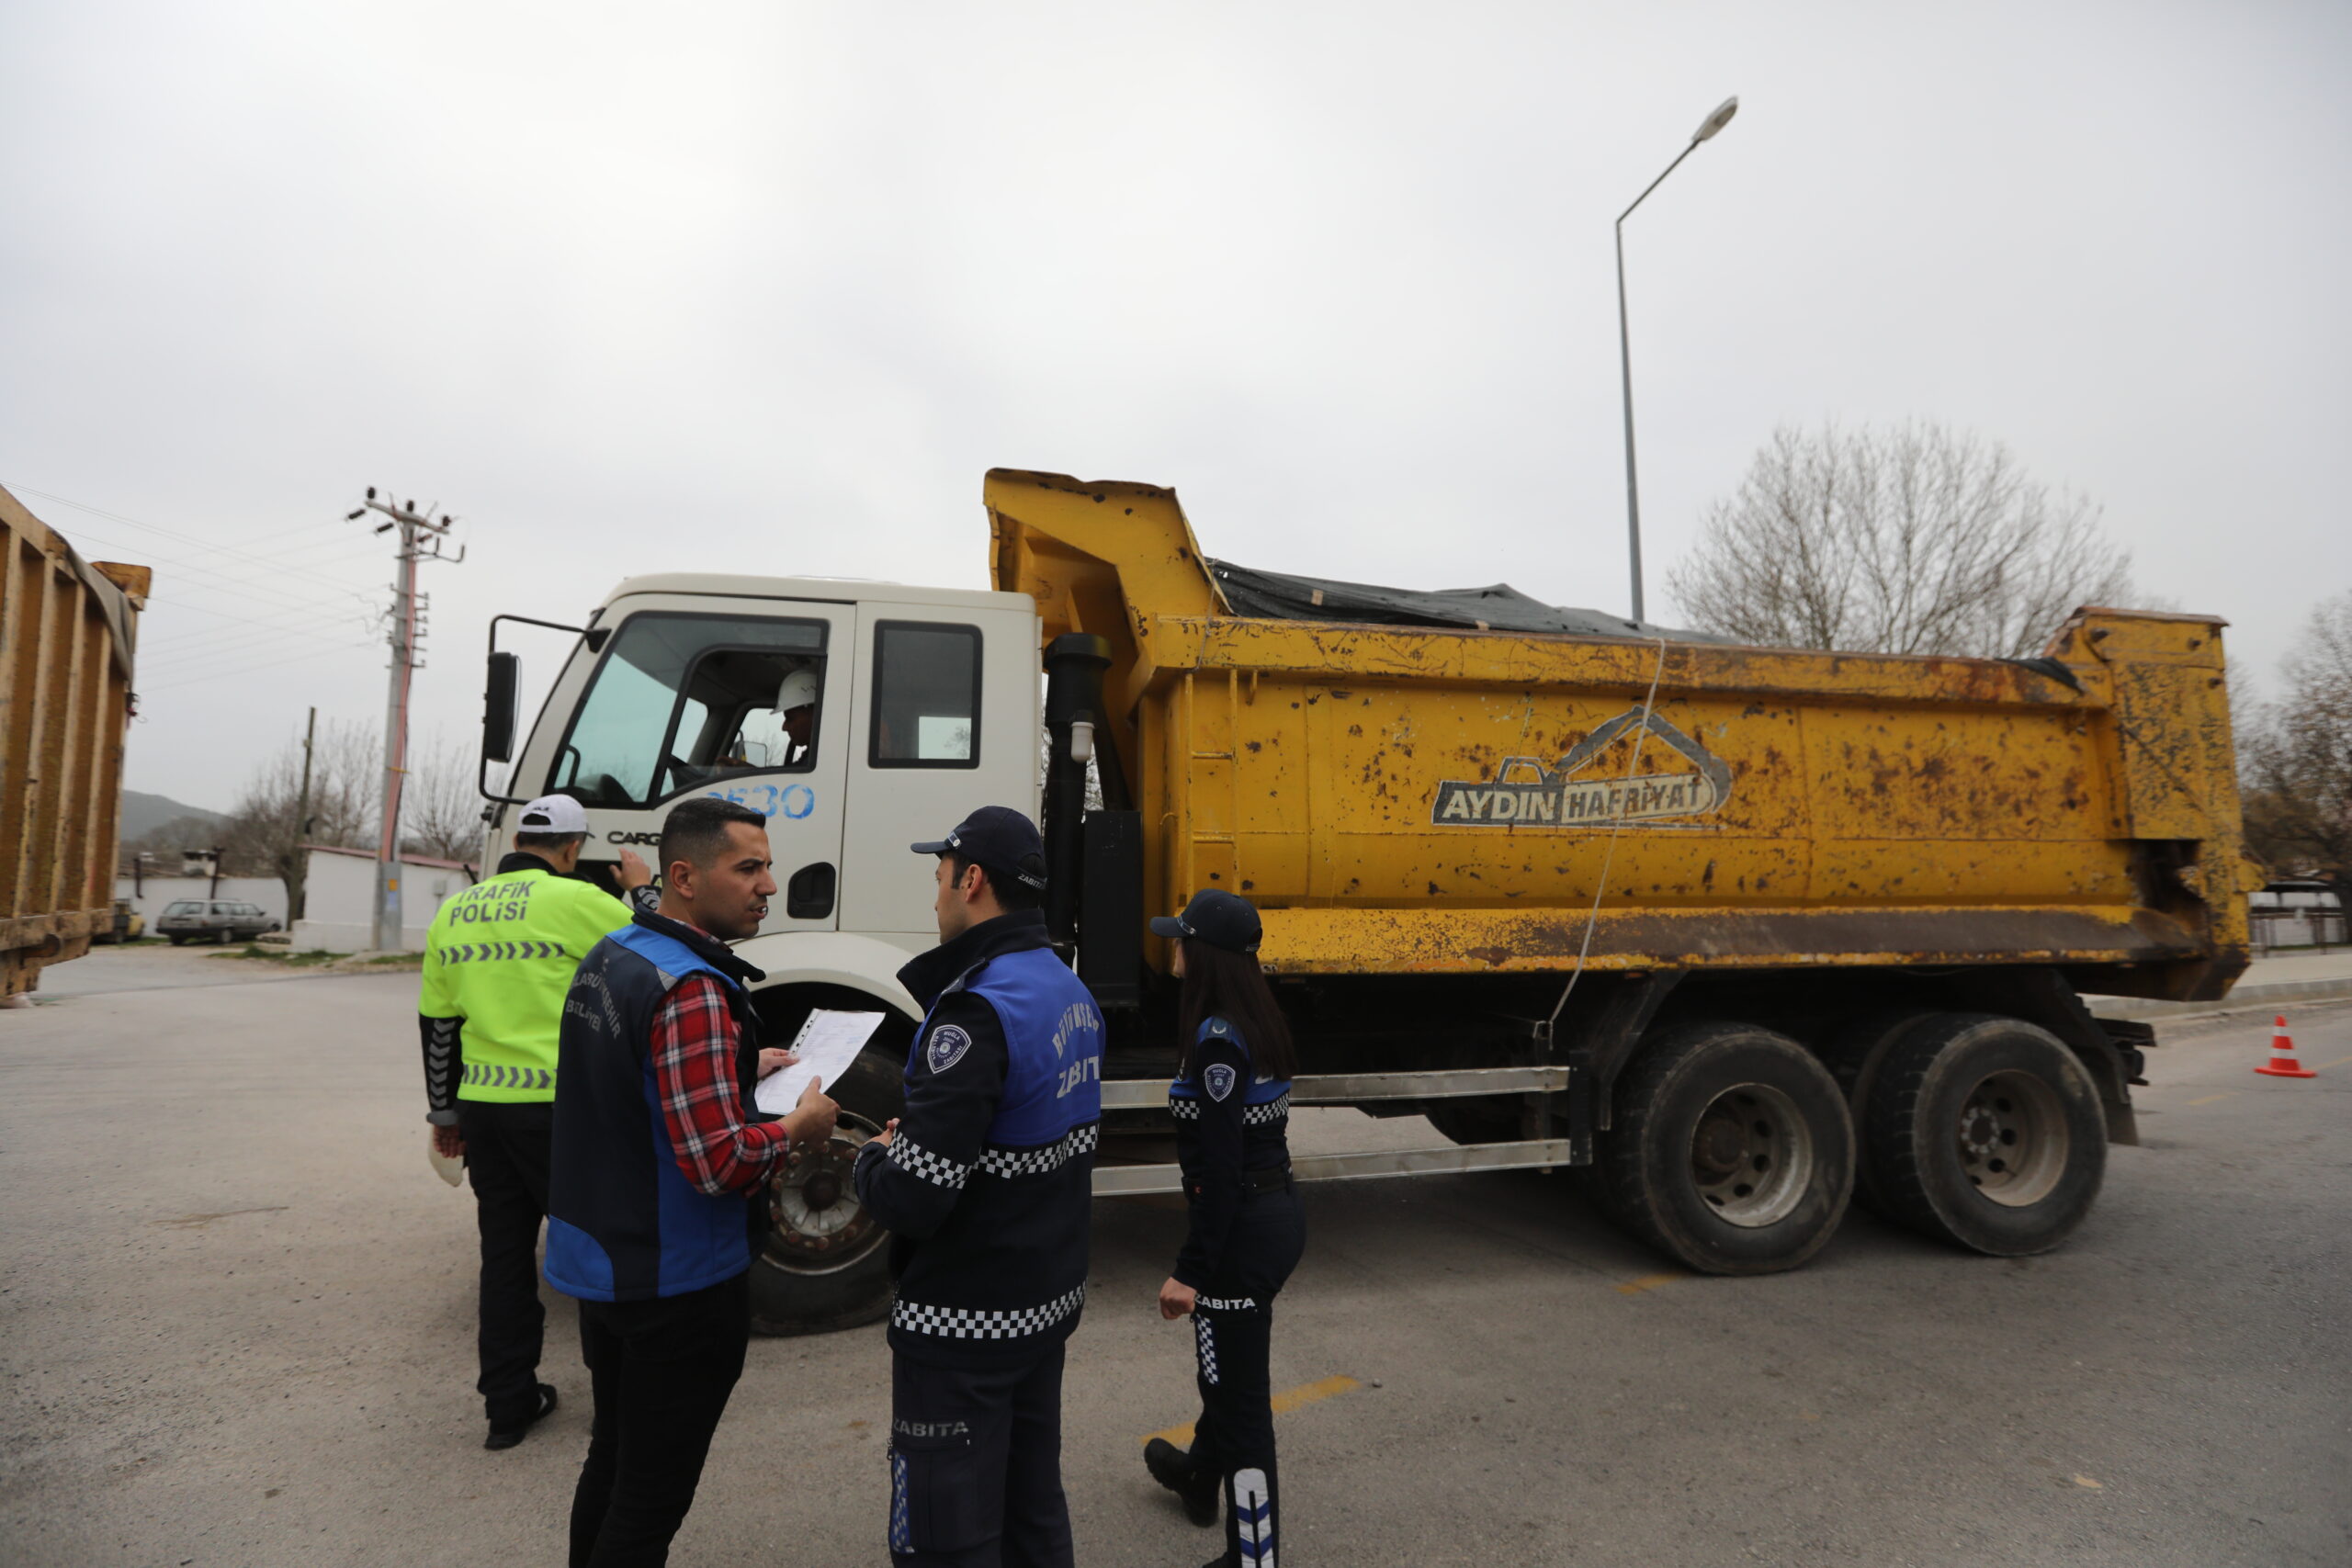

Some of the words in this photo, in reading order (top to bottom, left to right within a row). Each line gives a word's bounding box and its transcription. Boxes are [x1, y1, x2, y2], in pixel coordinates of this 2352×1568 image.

[707, 784, 815, 819] 530
[1442, 790, 1557, 820] AYDIN
[607, 830, 662, 846] CARG
[458, 881, 536, 903] TRAFİK
[449, 900, 527, 927] POLİSİ
[1057, 1055, 1100, 1099] ZABIT
[1195, 1292, 1256, 1310] ZABITA
